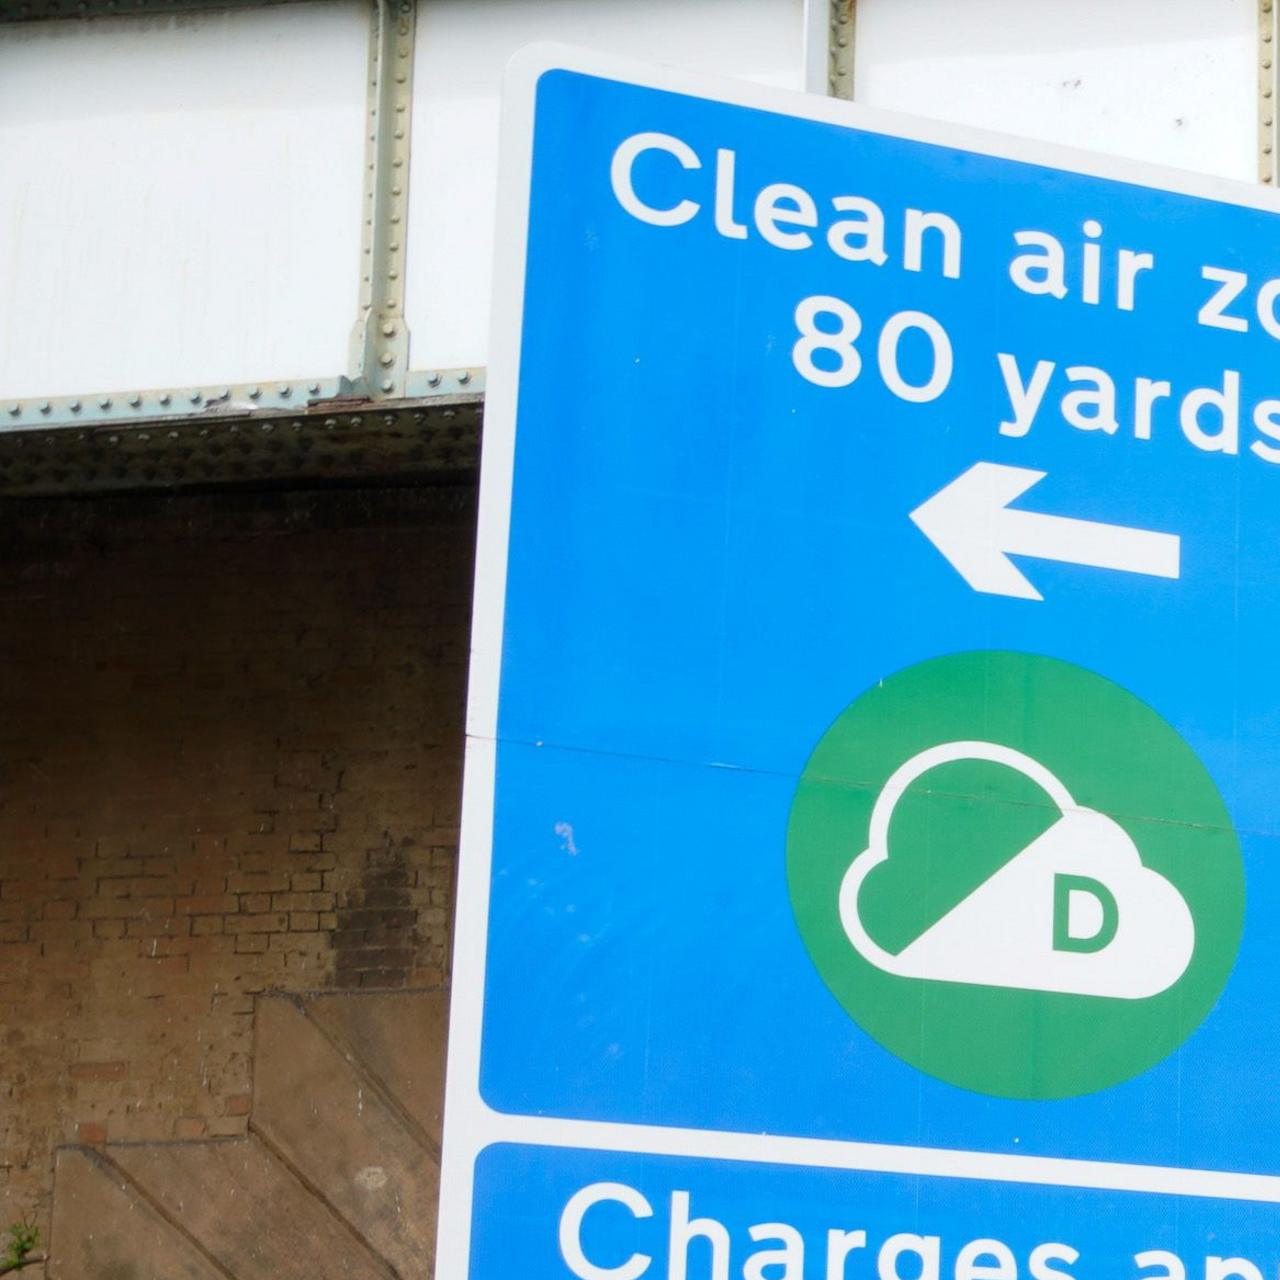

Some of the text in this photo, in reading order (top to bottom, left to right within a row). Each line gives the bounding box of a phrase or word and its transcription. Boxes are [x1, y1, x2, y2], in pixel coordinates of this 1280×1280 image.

[609, 131, 962, 281] Clean
[1007, 218, 1155, 312] air
[791, 294, 954, 404] 80
[1052, 872, 1119, 954] D
